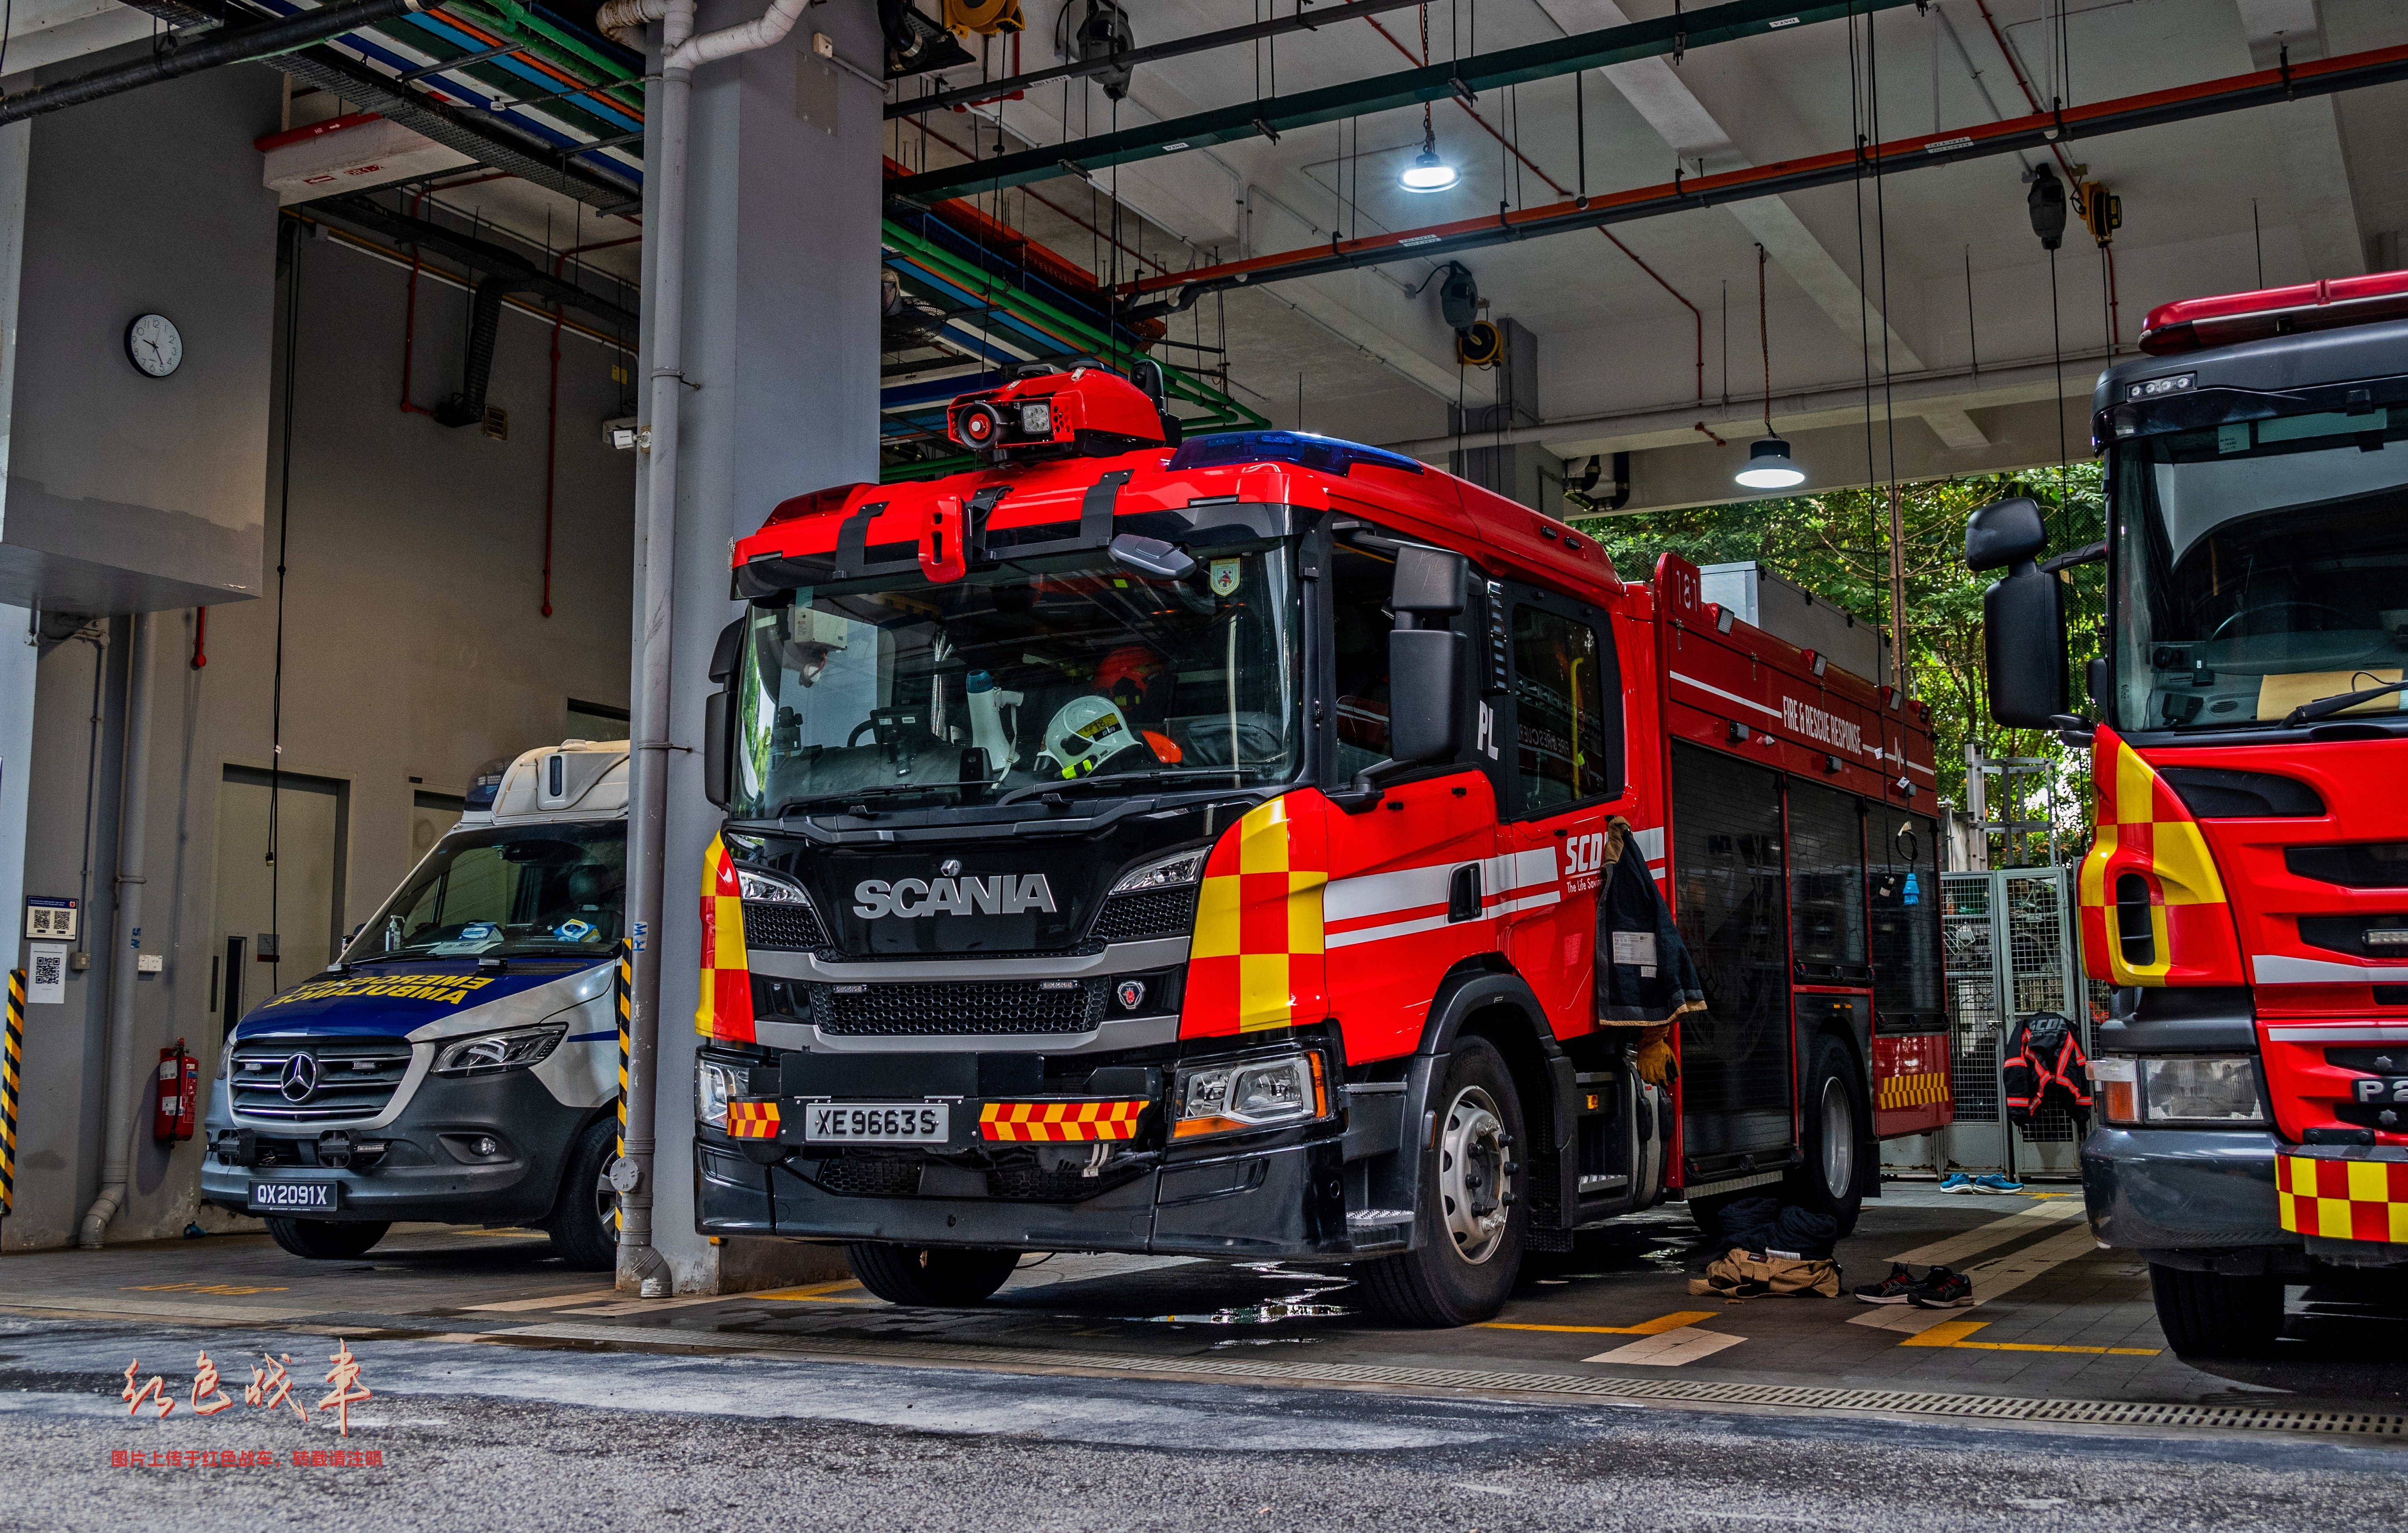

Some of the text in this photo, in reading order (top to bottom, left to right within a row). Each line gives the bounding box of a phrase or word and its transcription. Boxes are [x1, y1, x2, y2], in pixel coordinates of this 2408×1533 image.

[1676, 570, 1697, 612] 181
[1477, 700, 1499, 761] PL
[1783, 696, 1862, 755] FIRE & RESCUE RESPONSE
[853, 874, 1057, 919] SCANIA
[1567, 881, 1576, 893] The
[1578, 878, 1586, 891] Life
[2358, 1080, 2384, 1102] P
[818, 1109, 936, 1135] XE9663S
[258, 1185, 327, 1204] QX2091X
